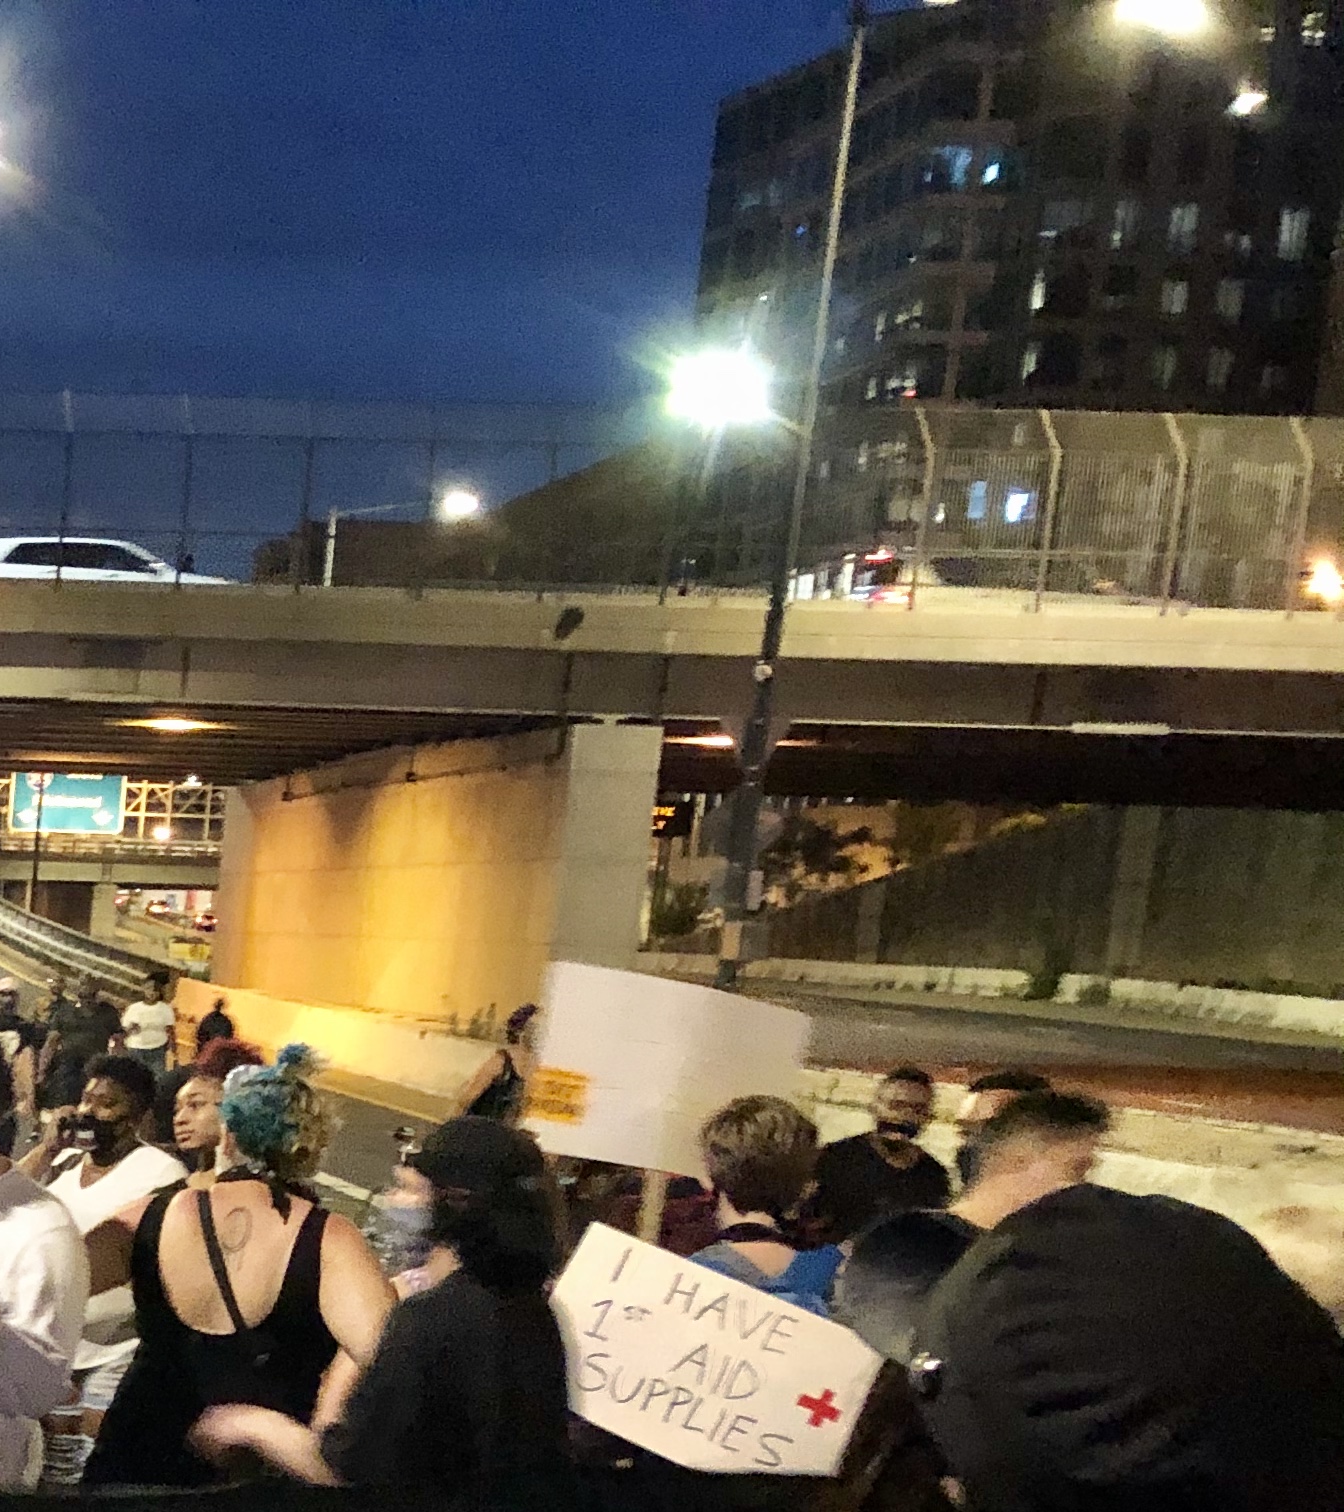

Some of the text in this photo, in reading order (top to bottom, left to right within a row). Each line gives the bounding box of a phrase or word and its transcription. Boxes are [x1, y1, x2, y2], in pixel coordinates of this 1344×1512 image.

[662, 1272, 800, 1355] HAVE
[575, 1352, 795, 1467] SUPPLIES
[668, 1342, 763, 1400] AID
